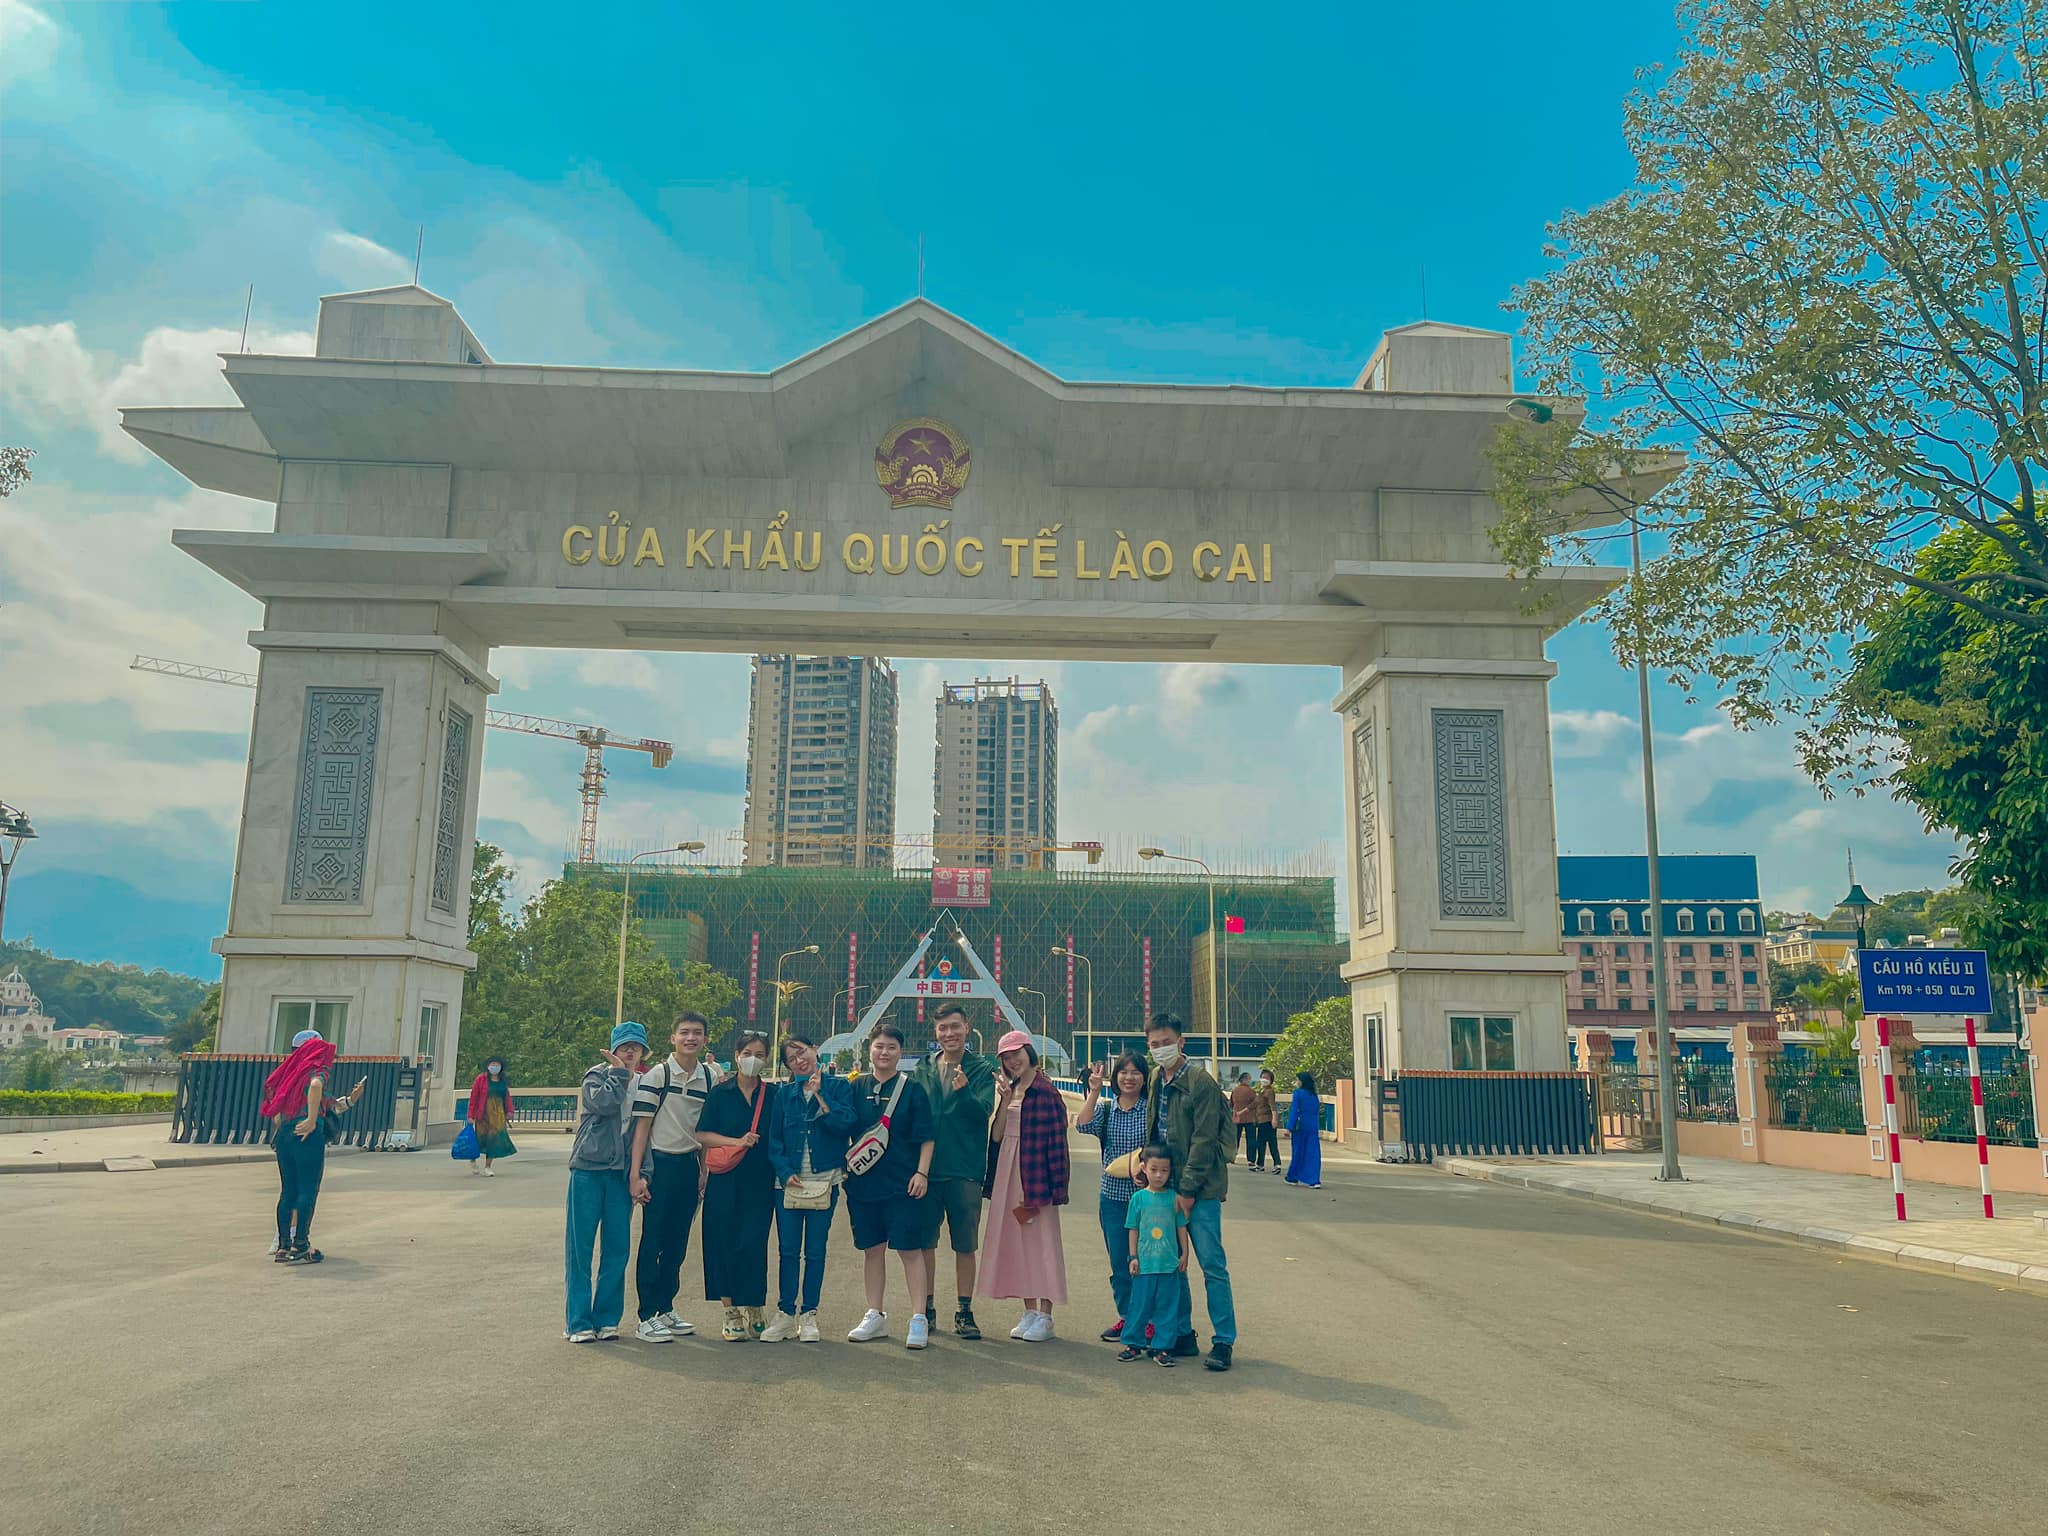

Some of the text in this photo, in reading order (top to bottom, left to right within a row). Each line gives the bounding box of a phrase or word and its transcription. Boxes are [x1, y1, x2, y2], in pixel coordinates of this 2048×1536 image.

[562, 511, 1273, 583] CỬA KHẨU QUỐC TẾ LÀO CAI
[957, 870, 986, 883] 云南
[1905, 956, 1924, 975] HỒ
[1964, 961, 1975, 975] II
[917, 980, 971, 994] 中国河口
[1877, 985, 1894, 995] Km
[1896, 985, 1912, 995] 198
[1925, 985, 1943, 995] 050
[853, 1148, 878, 1171] FILA
